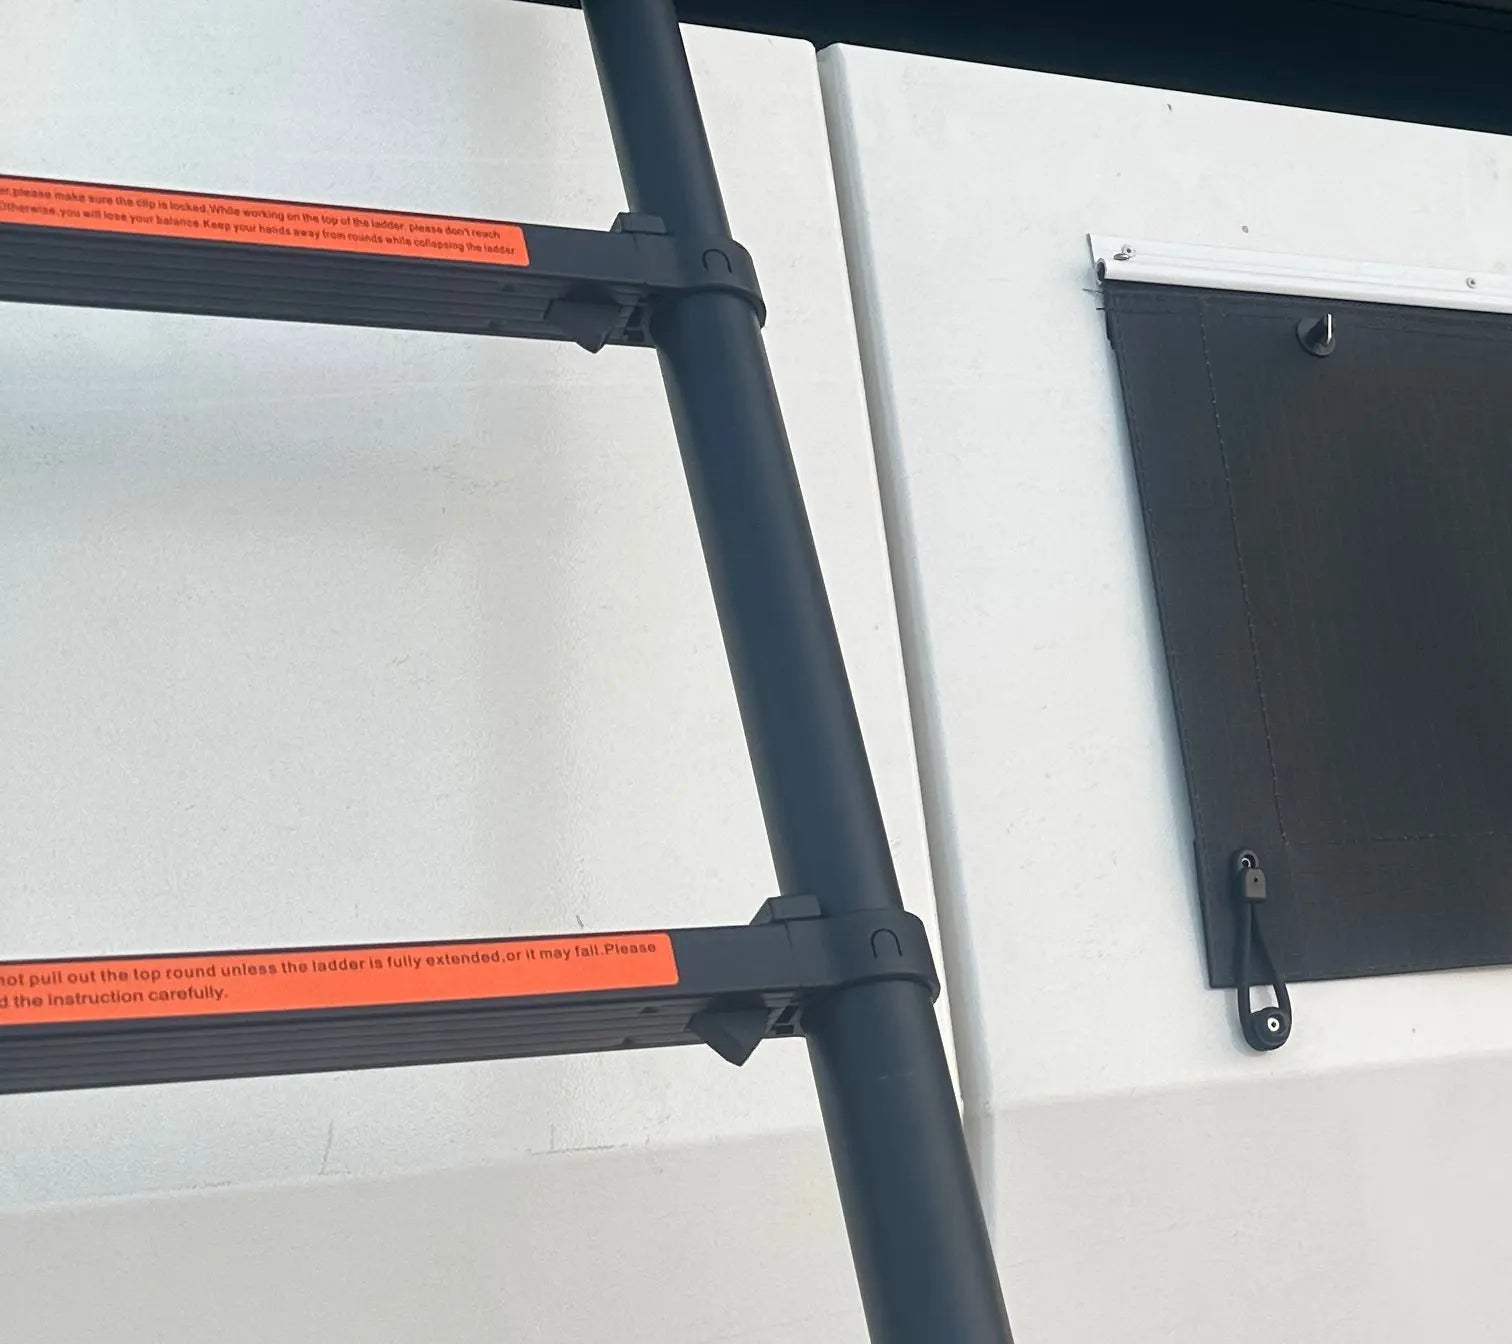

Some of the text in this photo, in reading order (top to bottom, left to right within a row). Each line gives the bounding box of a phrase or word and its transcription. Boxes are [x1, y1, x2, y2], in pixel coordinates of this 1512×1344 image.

[115, 196, 134, 206] the
[302, 212, 319, 222] the
[321, 214, 338, 225] top
[340, 216, 350, 225] of
[352, 217, 369, 226] the
[129, 214, 154, 224] your
[232, 223, 256, 232] your
[293, 229, 320, 239] away
[322, 229, 346, 239] from
[466, 242, 482, 251] the
[29, 970, 62, 988] pull
[66, 969, 96, 983] out
[99, 968, 128, 981] the
[133, 967, 160, 982] top
[165, 964, 215, 978] round
[220, 962, 277, 976] unless
[280, 960, 308, 973] the
[311, 958, 365, 971] ladder
[368, 956, 383, 968] is
[387, 955, 422, 969] fully
[525, 948, 536, 960] it
[539, 948, 571, 960] may
[13, 995, 43, 1007] the
[47, 989, 143, 1006] instruction
[147, 985, 227, 1000] carefully.
